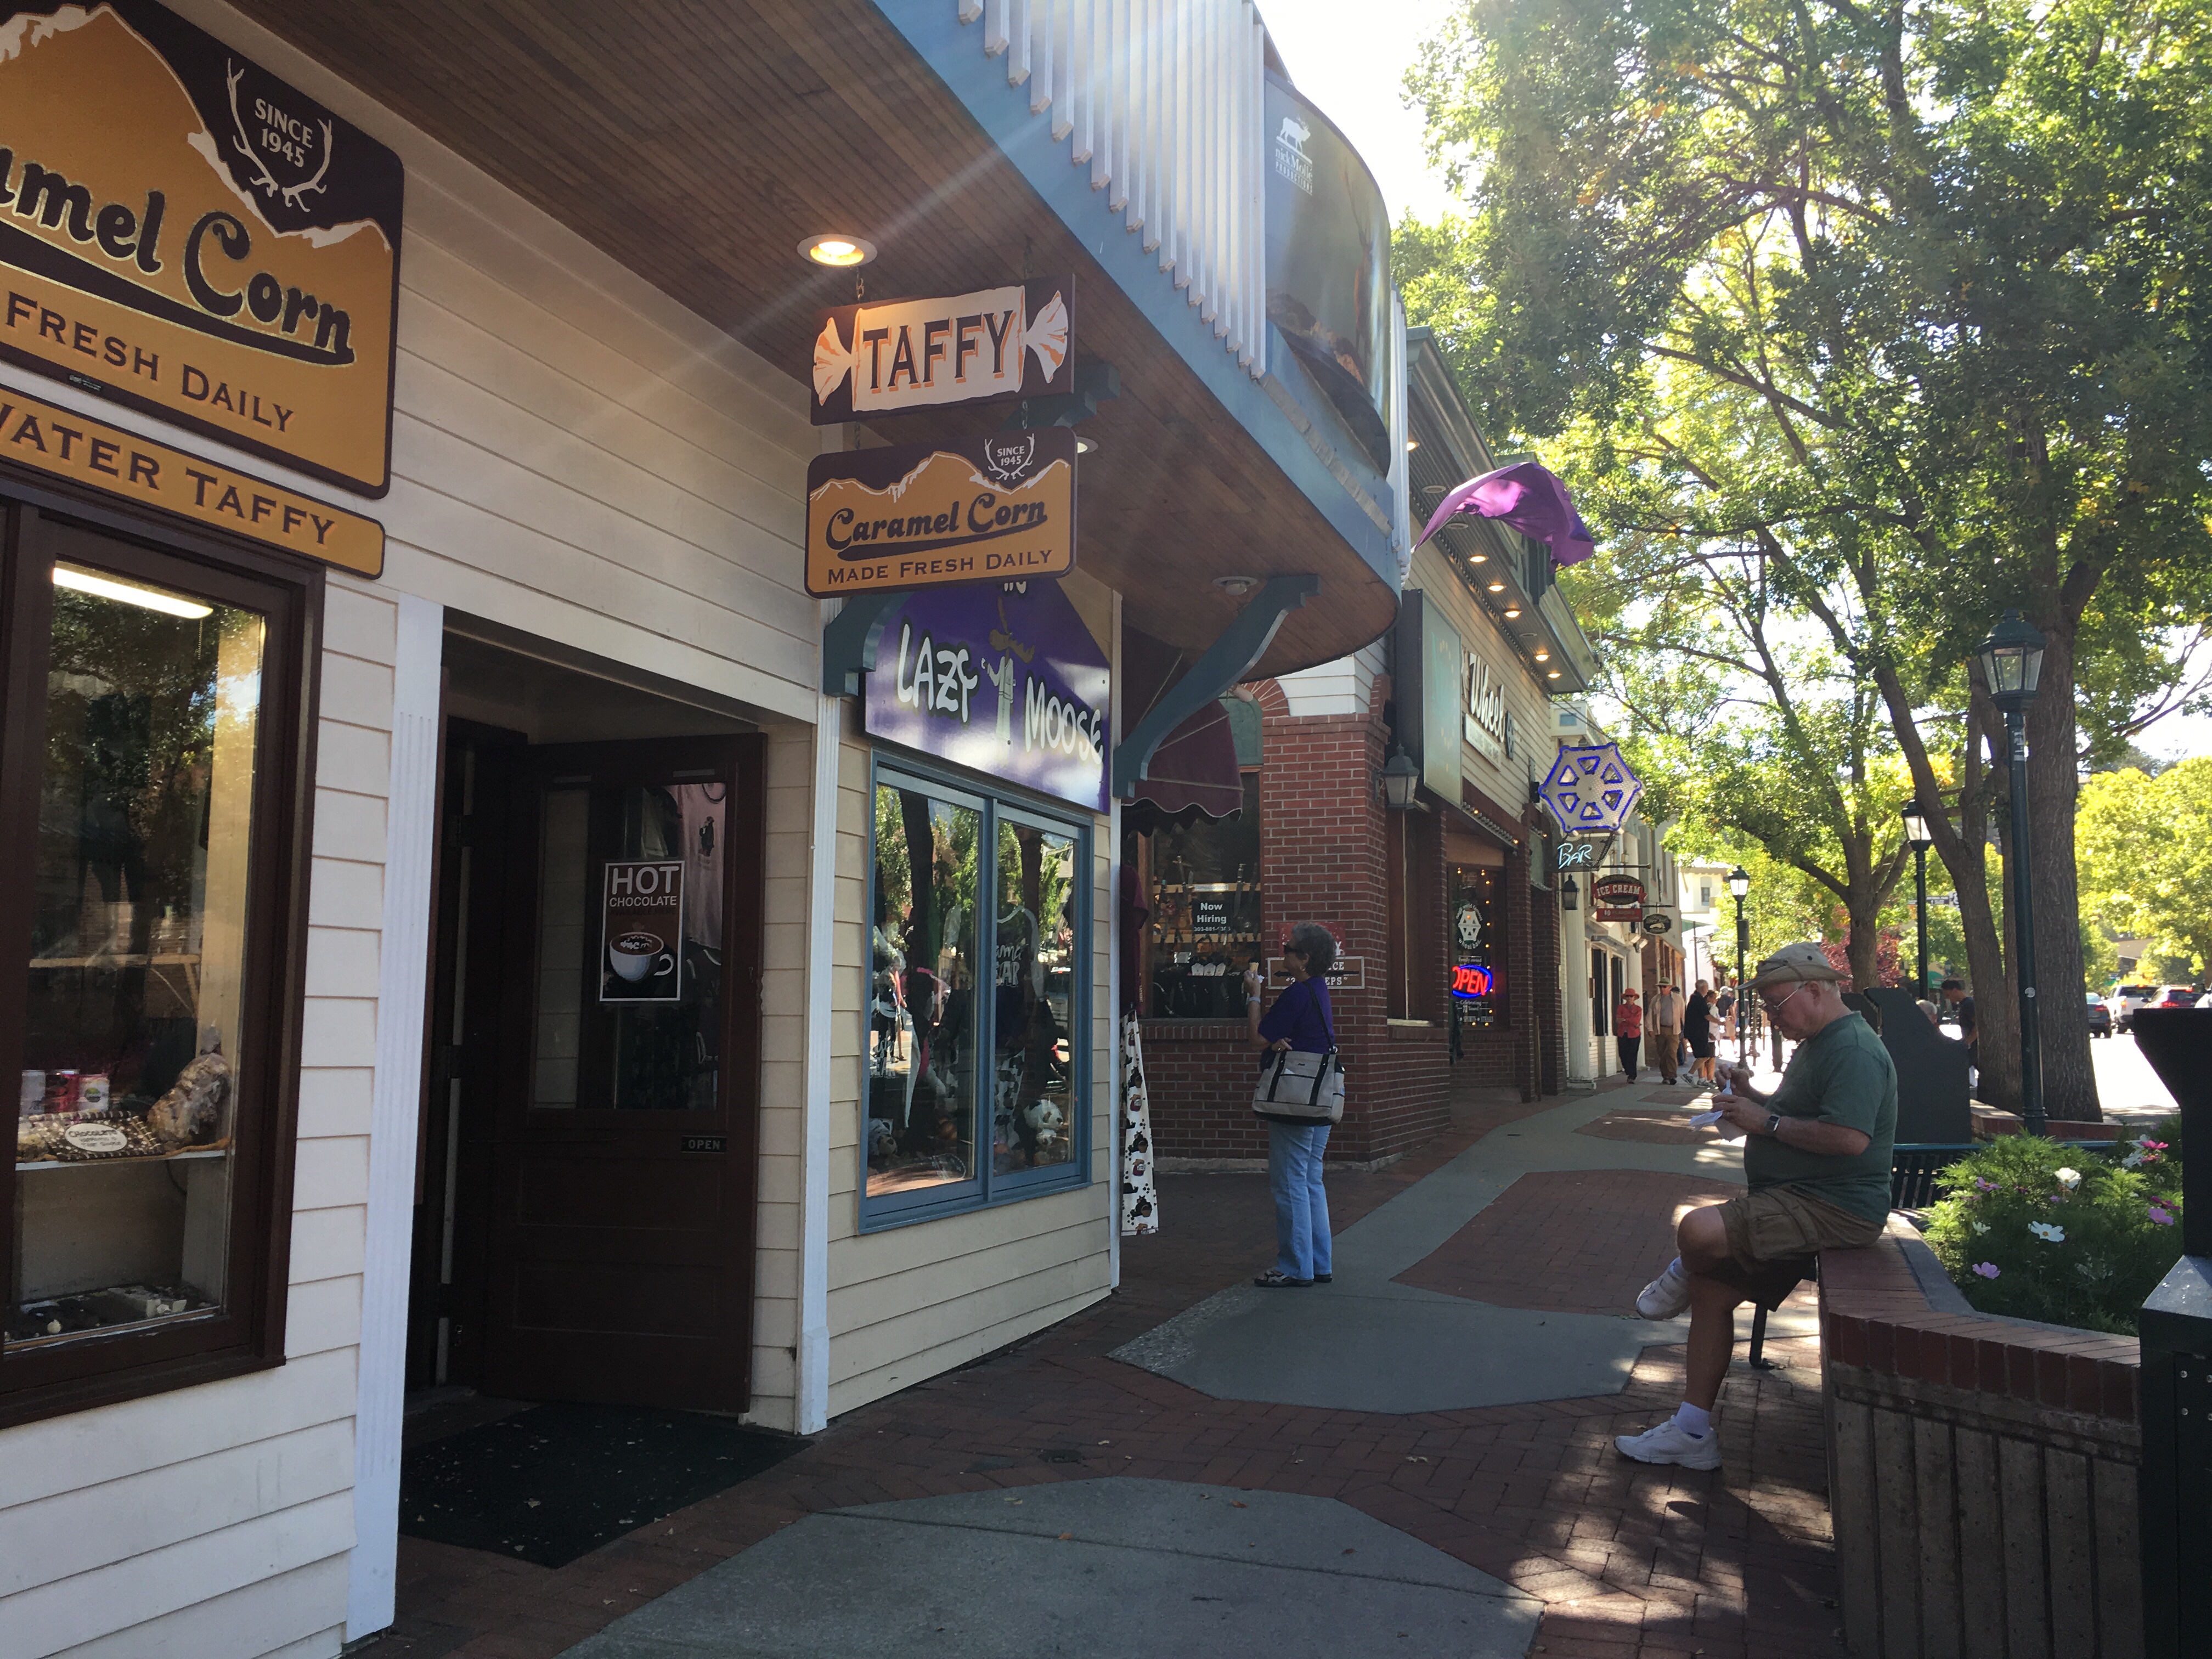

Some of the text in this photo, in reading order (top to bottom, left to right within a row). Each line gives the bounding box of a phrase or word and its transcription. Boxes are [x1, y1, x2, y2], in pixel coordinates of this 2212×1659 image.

[255, 99, 313, 149] SINCE
[261, 128, 305, 167] 1945
[183, 210, 356, 359] Corn
[6, 291, 295, 433] FRESH DAILY
[862, 309, 1015, 393] TAFFY
[997, 445, 1025, 457] SINCE
[1000, 455, 1022, 466] 1945
[186, 467, 336, 545] TAFFY
[826, 493, 1048, 550] Caramel Corn
[828, 550, 1053, 585] MADE FRESH DAILY
[897, 623, 1103, 765] LAZY MOOSE
[1469, 652, 1505, 743] Wheel
[1558, 843, 1593, 869] BAR
[612, 866, 680, 895] HOT
[1596, 884, 1640, 897] ICE CREAM
[609, 895, 677, 907] CHOCOLATE
[1200, 902, 1223, 911] Now
[1197, 915, 1227, 924] Hiring
[688, 1139, 720, 1150] OPEN
